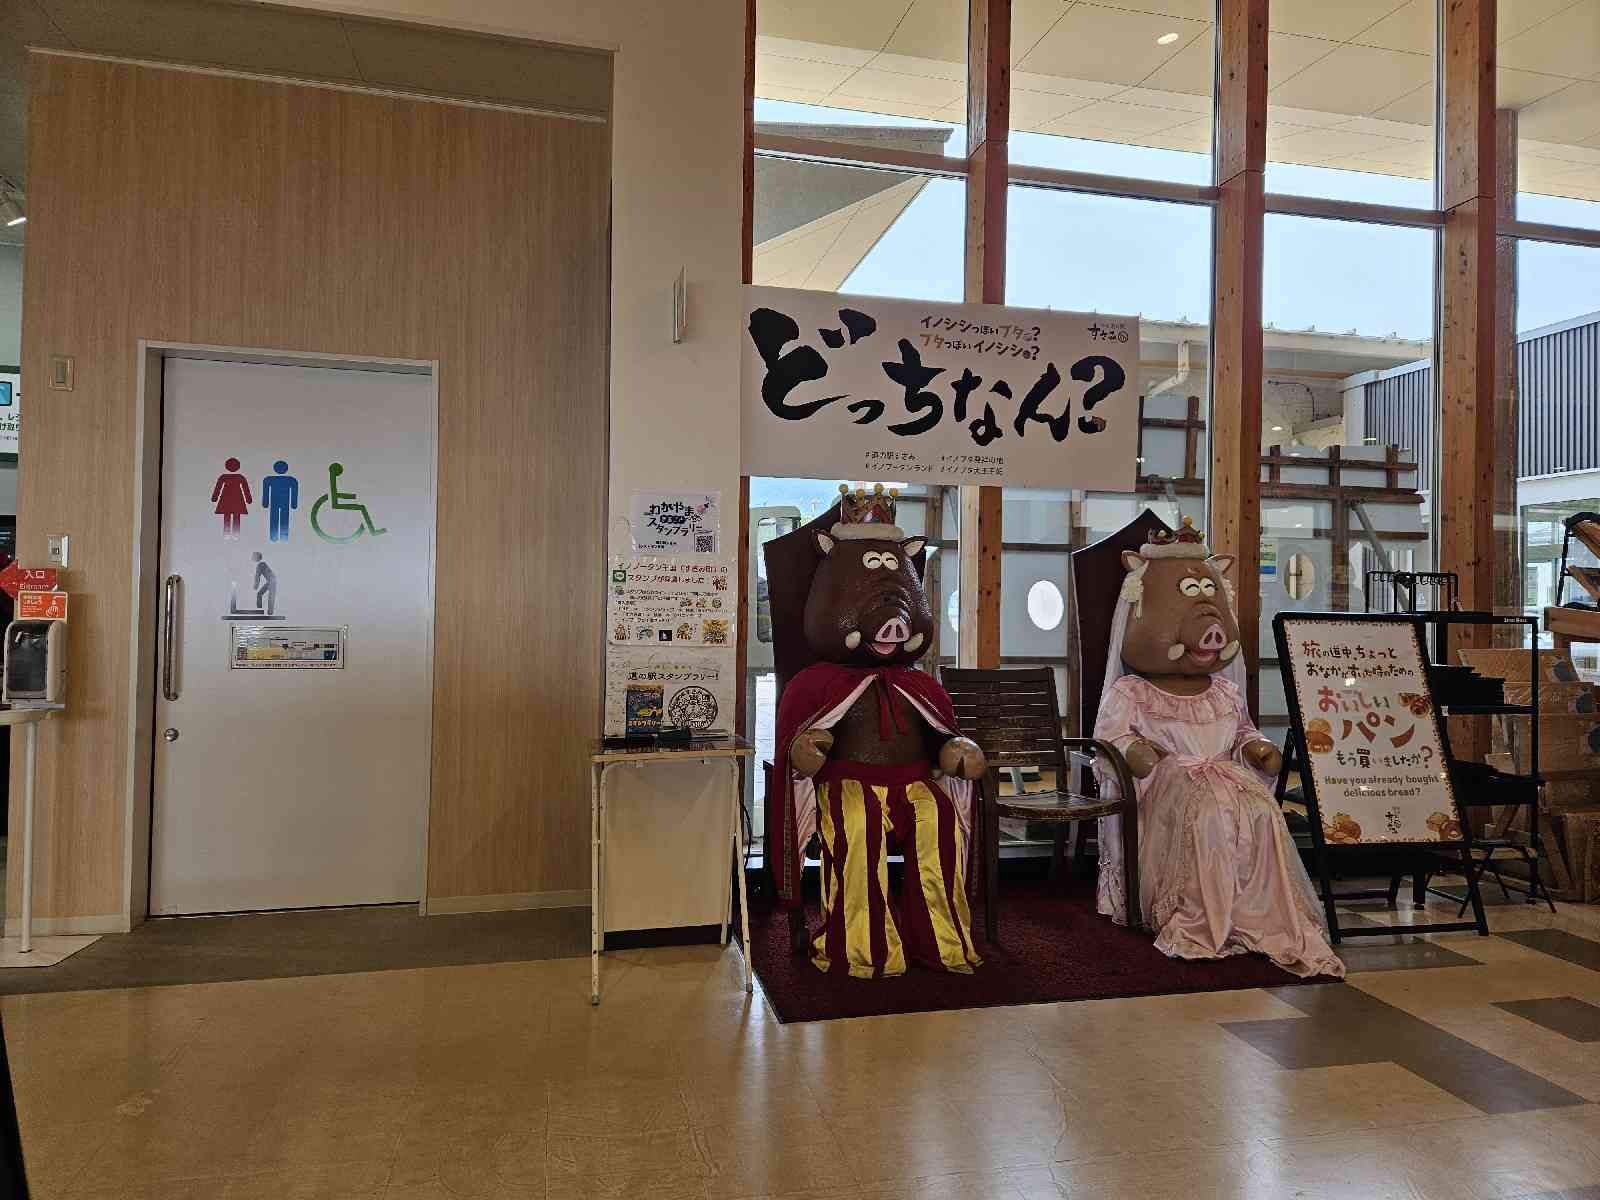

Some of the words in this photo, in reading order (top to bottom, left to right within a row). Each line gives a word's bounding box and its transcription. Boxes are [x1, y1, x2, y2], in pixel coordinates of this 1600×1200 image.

[748, 307, 1126, 447] どっちなん?
[24, 569, 46, 581] 入口
[1317, 686, 1391, 713] おいしい
[1341, 711, 1416, 749] パン
[1325, 776, 1348, 785] Have
[1349, 777, 1367, 786] you
[1368, 775, 1404, 788] already
[1405, 775, 1440, 786] bought
[1343, 789, 1387, 798] delicious
[1387, 787, 1421, 798] bread?
